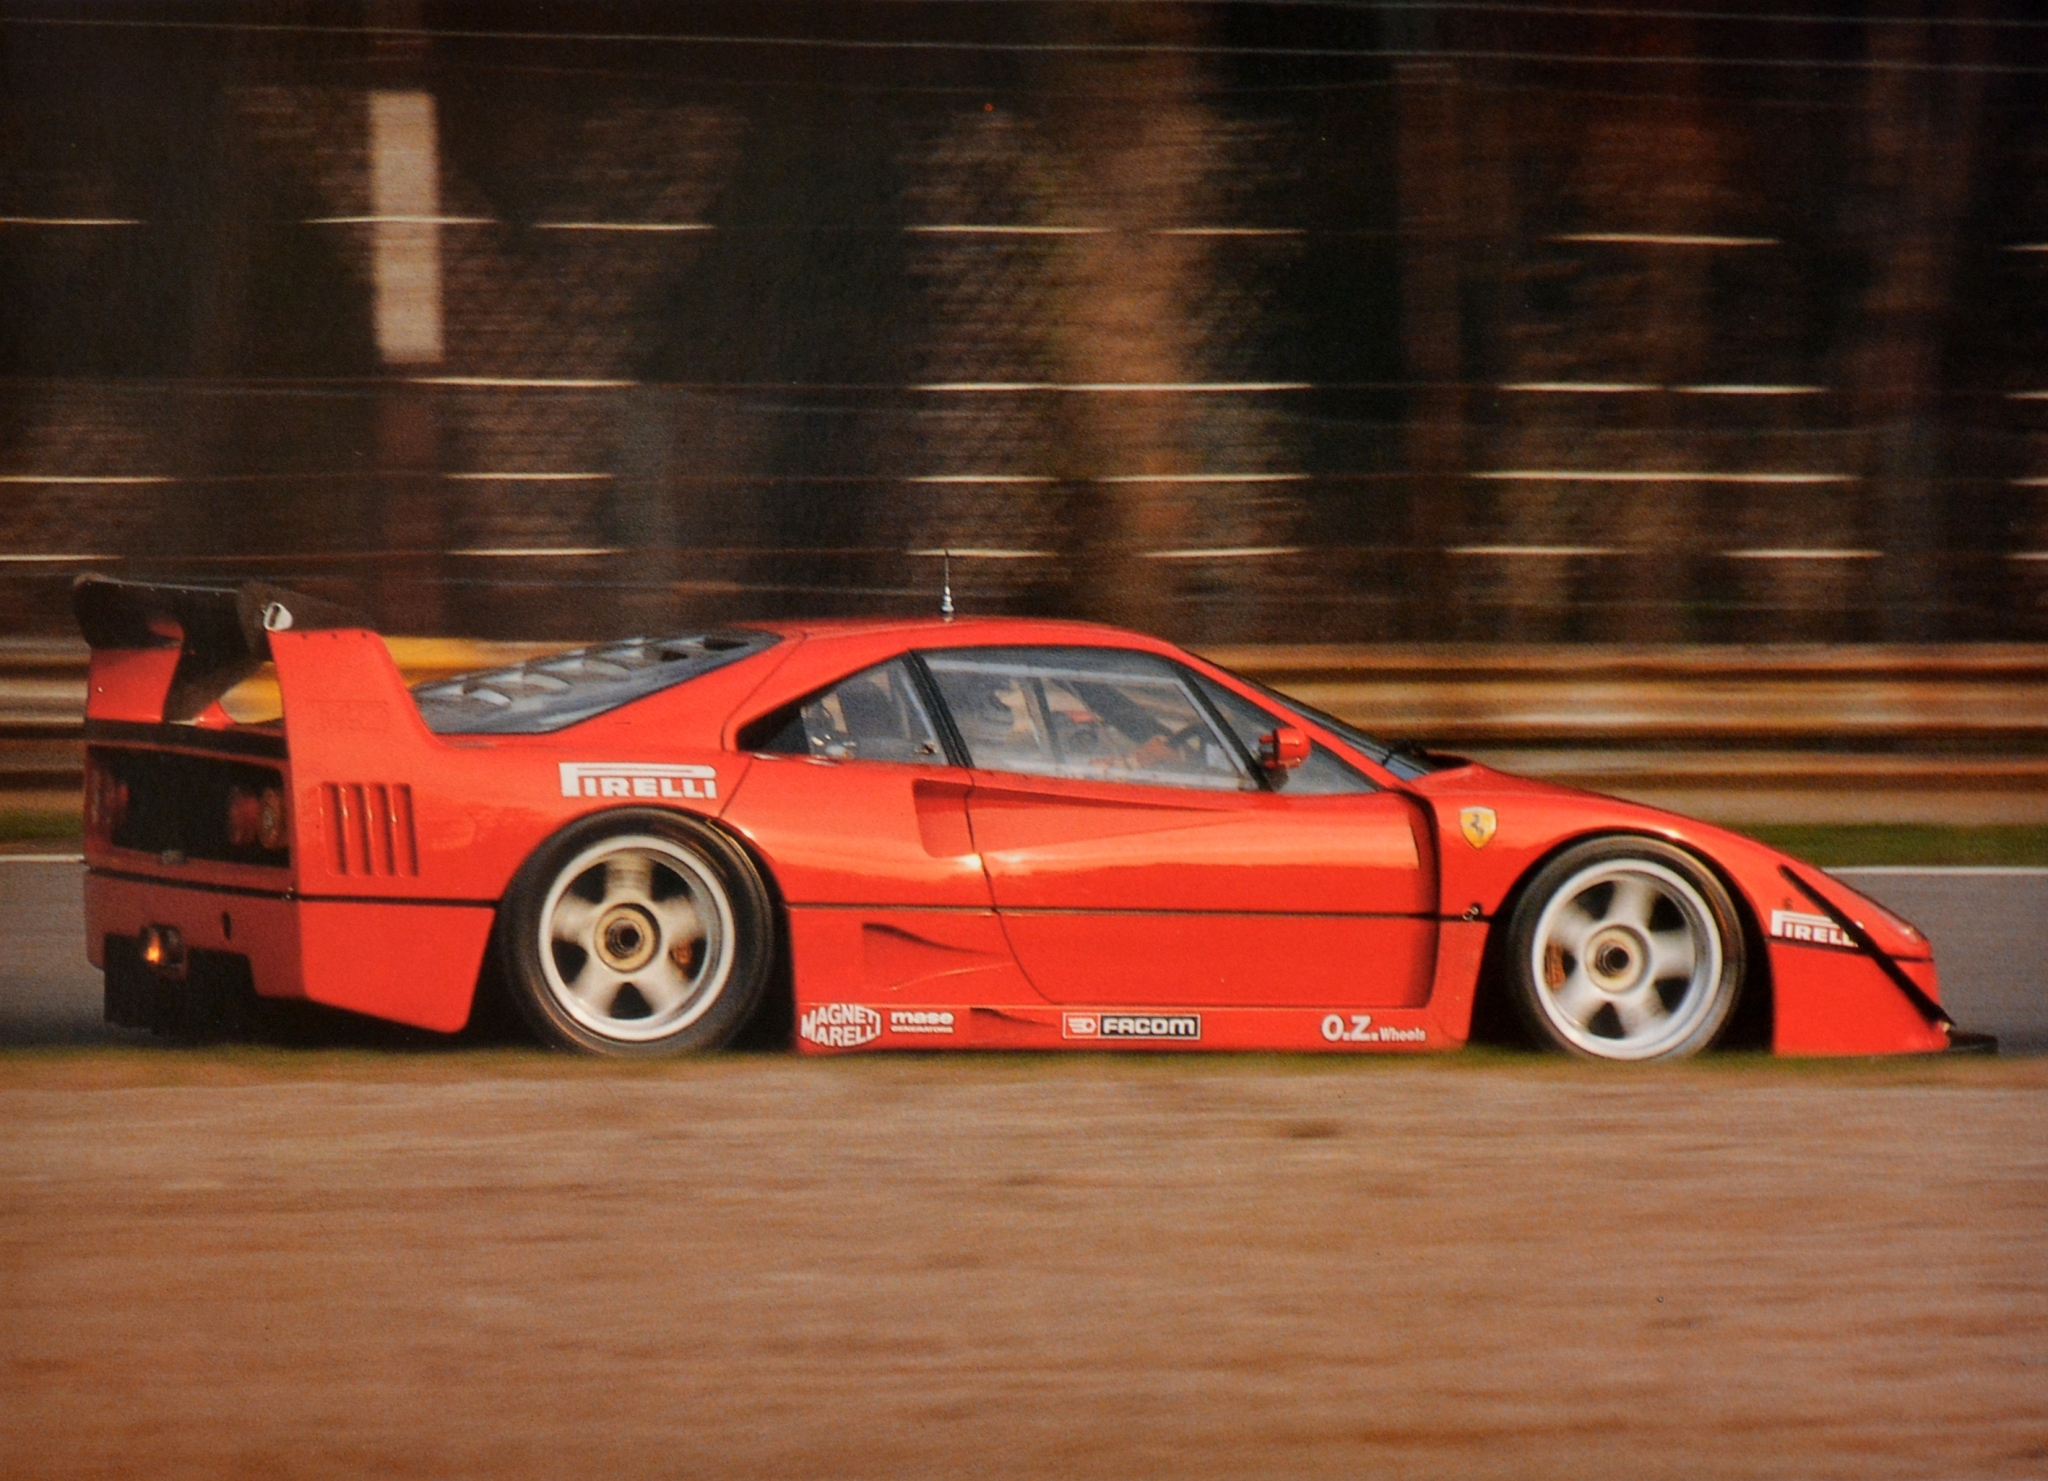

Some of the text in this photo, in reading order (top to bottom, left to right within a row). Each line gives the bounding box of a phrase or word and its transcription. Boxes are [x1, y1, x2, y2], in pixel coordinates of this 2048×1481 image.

[558, 762, 717, 799] PIRELLI
[1771, 909, 1864, 948] PIRELL
[1103, 1018, 1195, 1034] FACOM
[1379, 1026, 1426, 1042] Wheels
